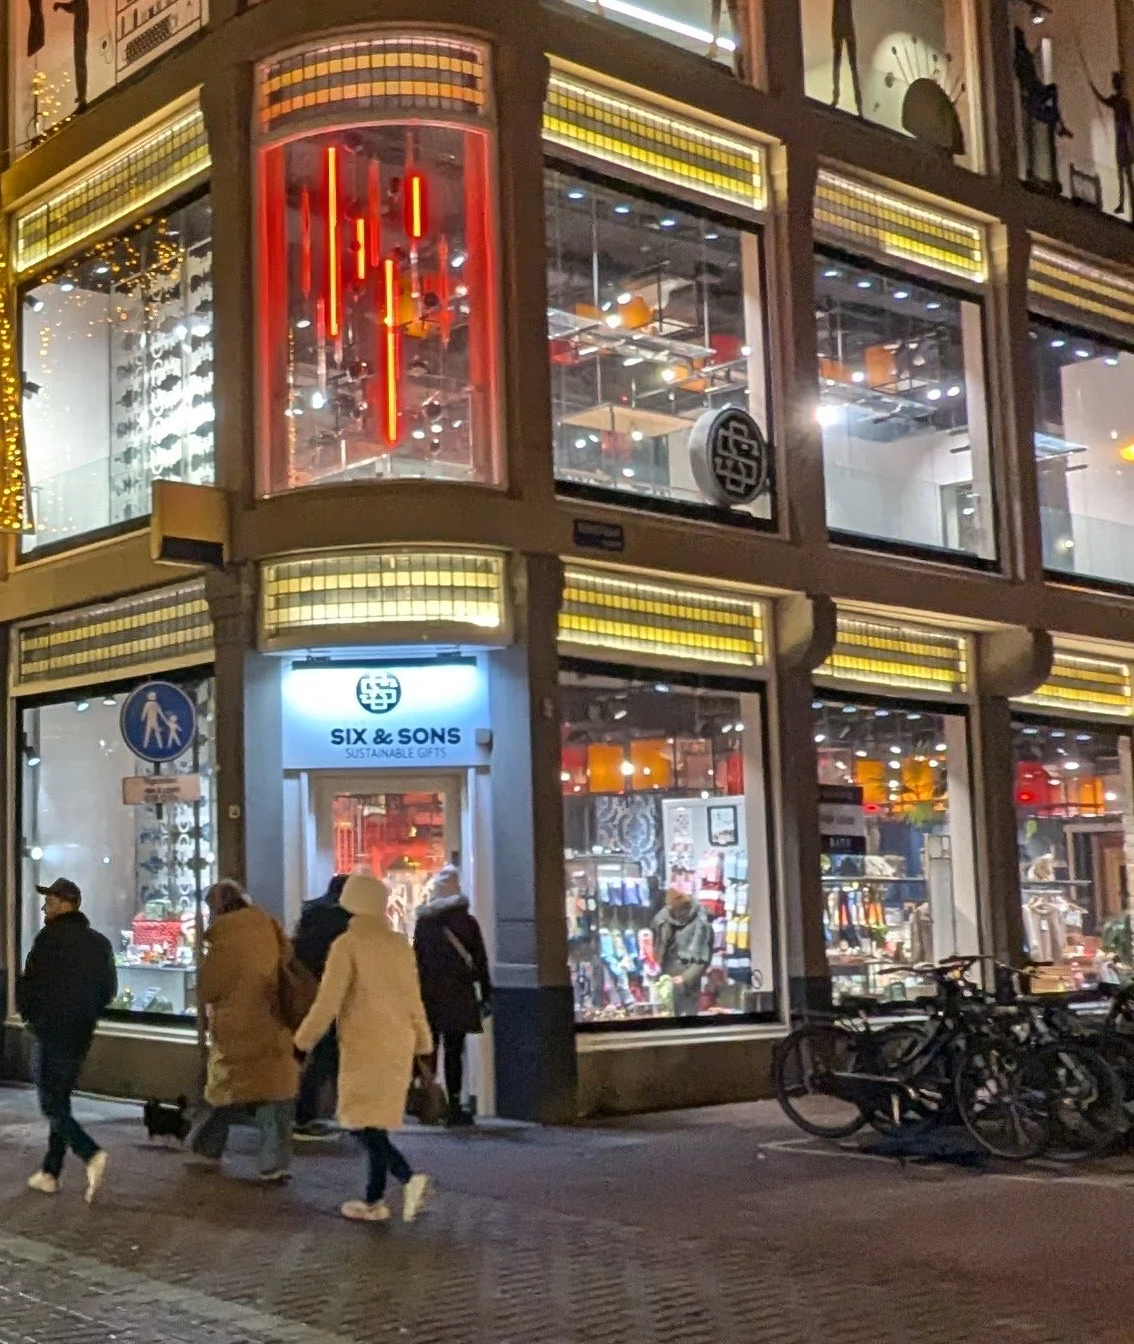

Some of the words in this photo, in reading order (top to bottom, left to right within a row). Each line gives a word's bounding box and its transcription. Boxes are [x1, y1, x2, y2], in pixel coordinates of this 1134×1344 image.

[331, 728, 368, 745] SIX
[373, 728, 393, 745] &
[398, 727, 461, 744] SONS
[346, 747, 414, 759] SUSTAINABLE
[418, 747, 447, 758] GIFTS
